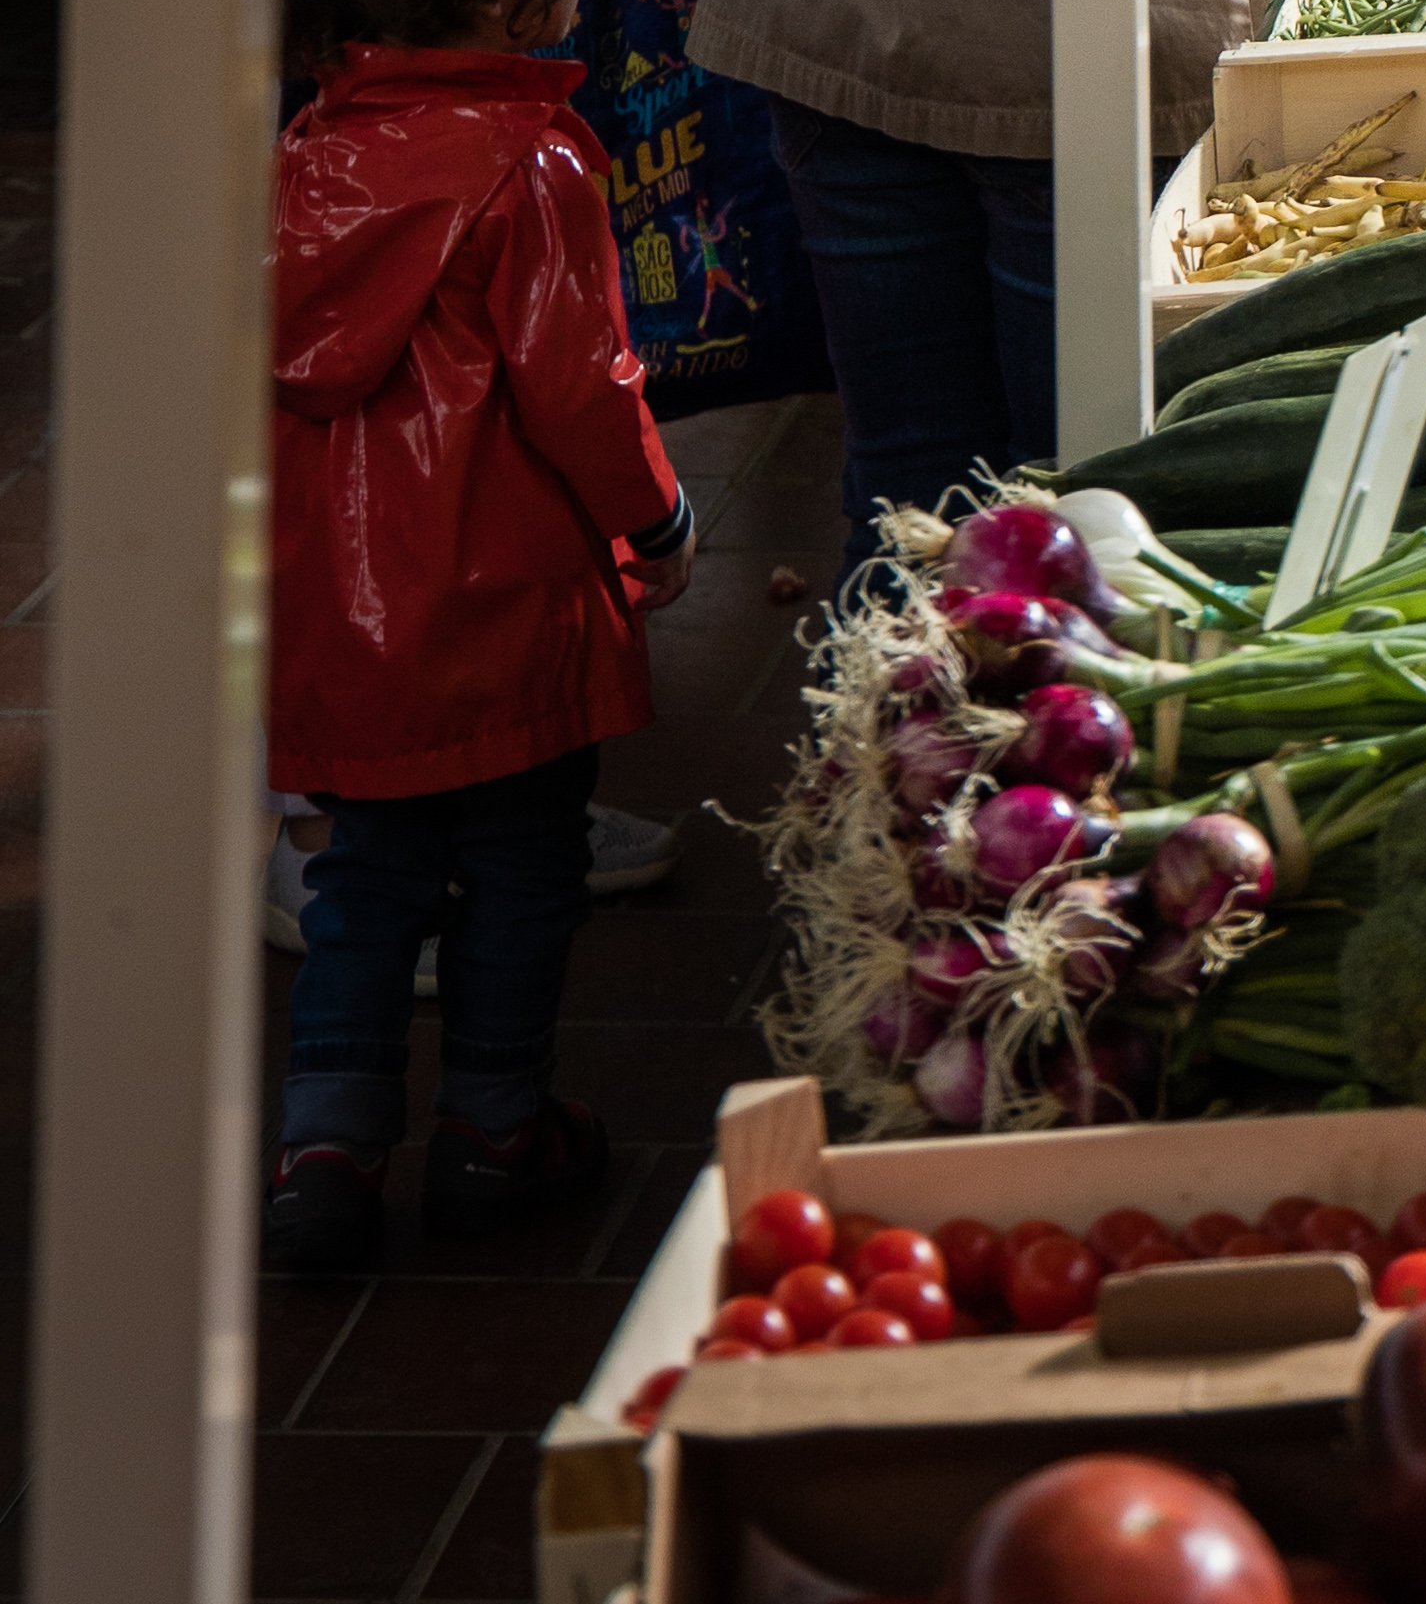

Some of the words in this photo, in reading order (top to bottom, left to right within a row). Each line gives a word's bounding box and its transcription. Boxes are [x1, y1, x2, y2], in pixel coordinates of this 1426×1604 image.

[622, 190, 656, 233] AVEC
[660, 168, 691, 201] MOI
[636, 243, 671, 271] SAC
[641, 272, 676, 303] DOS
